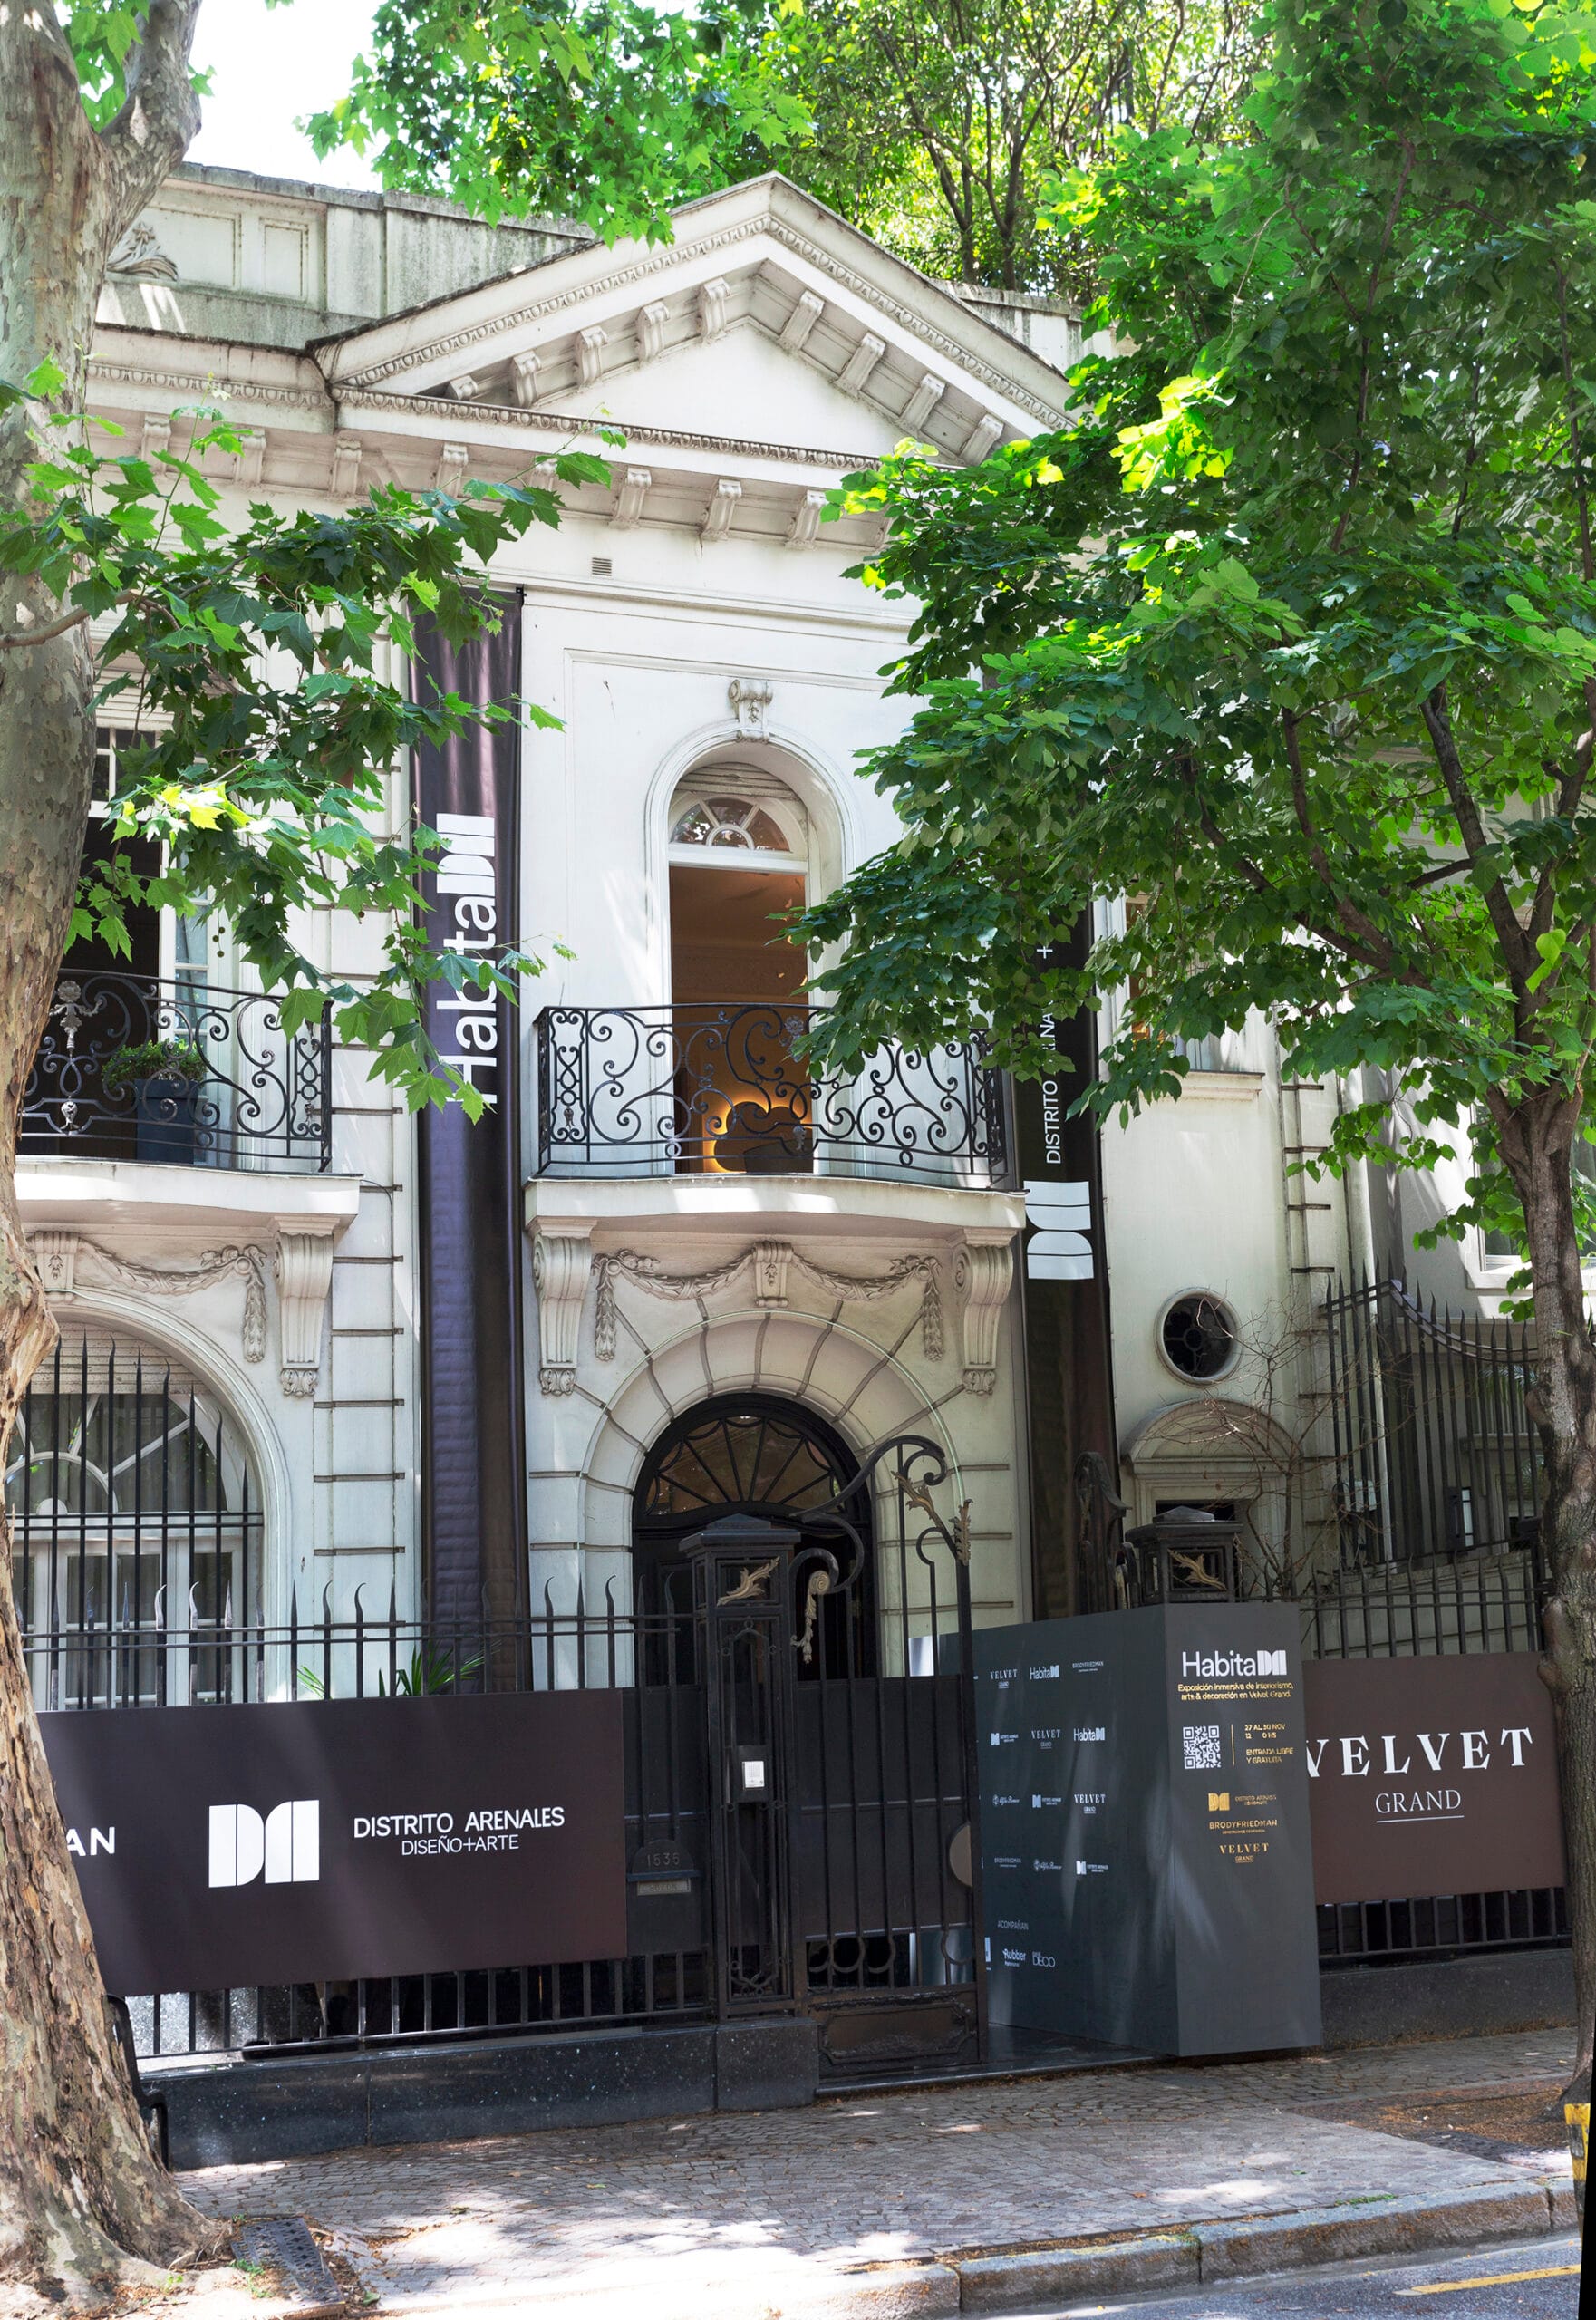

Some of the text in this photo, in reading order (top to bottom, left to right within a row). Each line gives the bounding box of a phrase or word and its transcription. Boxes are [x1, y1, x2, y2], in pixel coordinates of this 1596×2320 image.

[1042, 1080, 1061, 1165] DISTRITO
[990, 1668, 1018, 1680] VELVET
[1178, 1683, 1214, 1693] Exposición
[1245, 1681, 1254, 1690] de
[1181, 1692, 1195, 1701] arte
[1272, 1723, 1286, 1731] NOV
[1031, 1728, 1061, 1740] VELVET
[1246, 1747, 1276, 1756] ENTRADA
[1245, 1756, 1252, 1764] Y
[1073, 1793, 1107, 1804] VELVET
[1375, 1789, 1461, 1813] GRAND
[353, 1807, 566, 1839] DISTRITO ARENALES
[1209, 1819, 1278, 1830] BRODYFRIEDMAN
[401, 1834, 519, 1856] DISEÑO+ARTE
[1219, 1842, 1270, 1854] VELVET
[997, 1919, 1030, 1930] ACOMPAÑAN
[1002, 1948, 1027, 1961] Rubber
